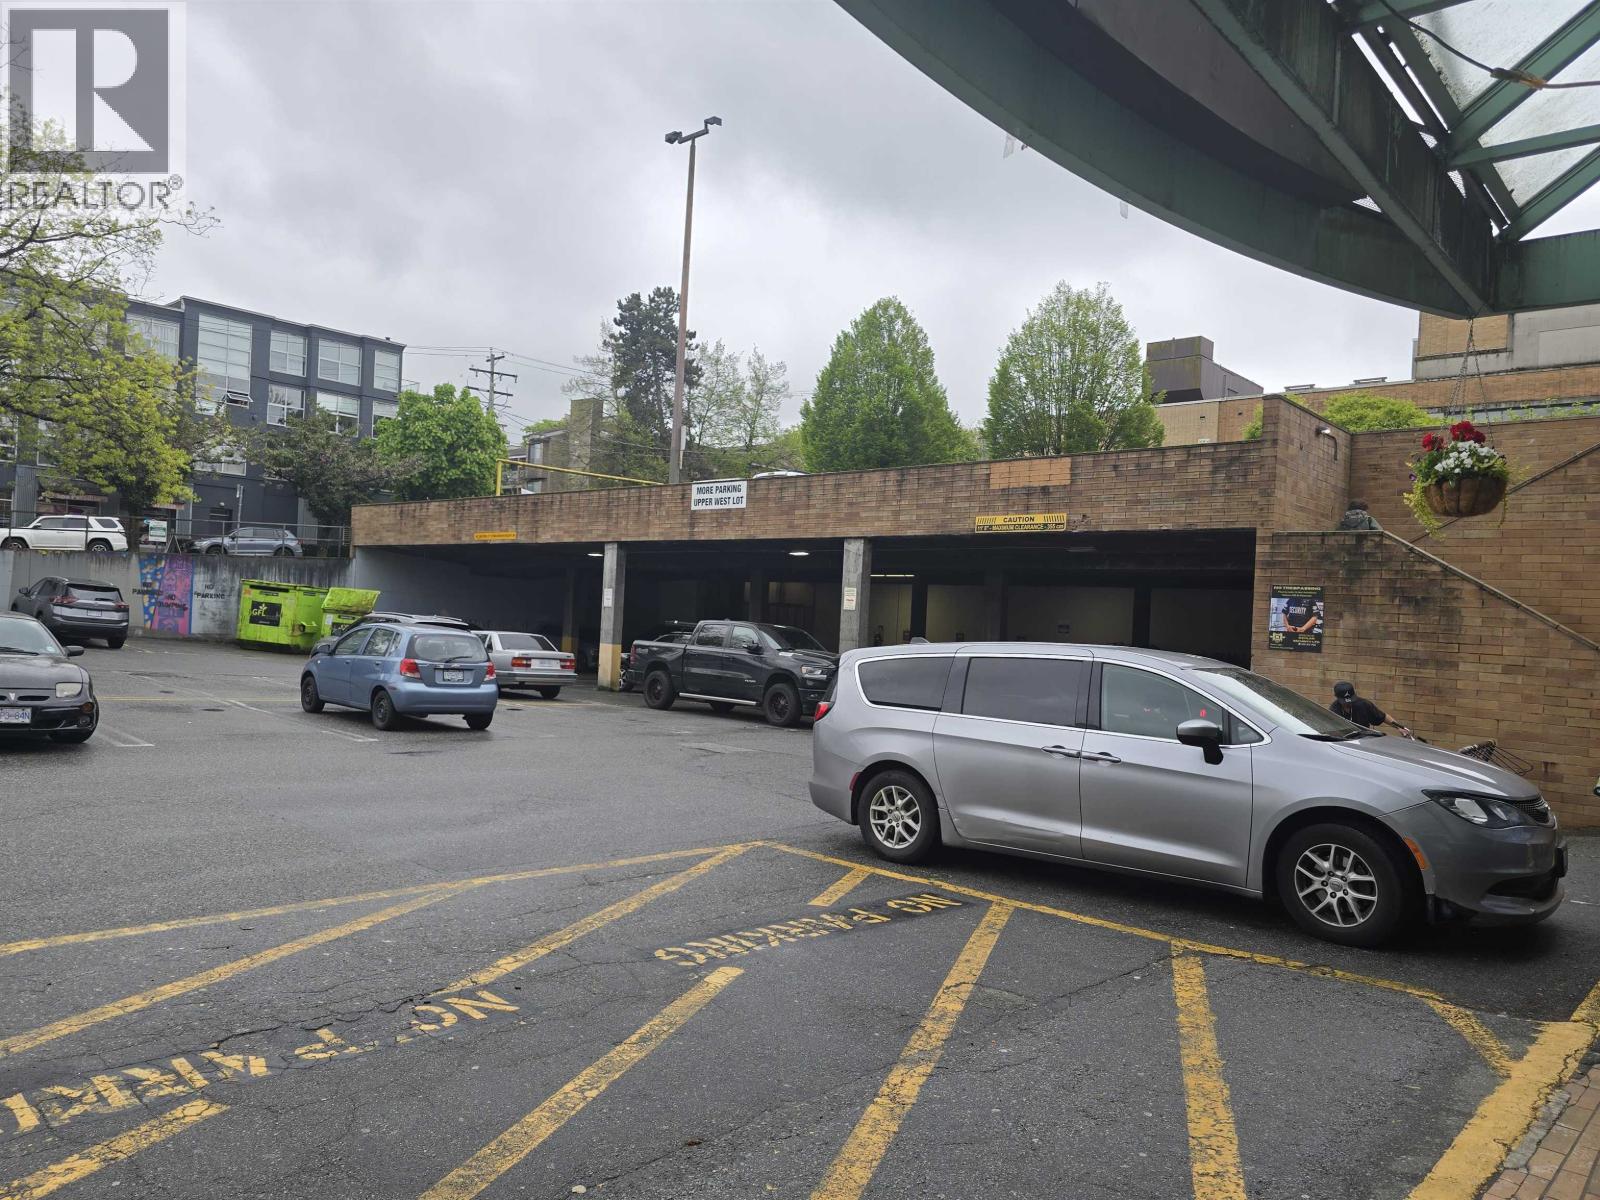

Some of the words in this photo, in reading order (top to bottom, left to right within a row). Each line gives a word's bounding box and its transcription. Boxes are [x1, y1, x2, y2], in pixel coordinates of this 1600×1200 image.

[696, 486, 714, 495] MORE
[715, 484, 742, 494] PARKING
[693, 498, 713, 507] UPPER
[714, 497, 732, 506] WEST
[732, 496, 744, 505] LOT
[252, 608, 267, 617] GFL
[887, 893, 962, 913] NO
